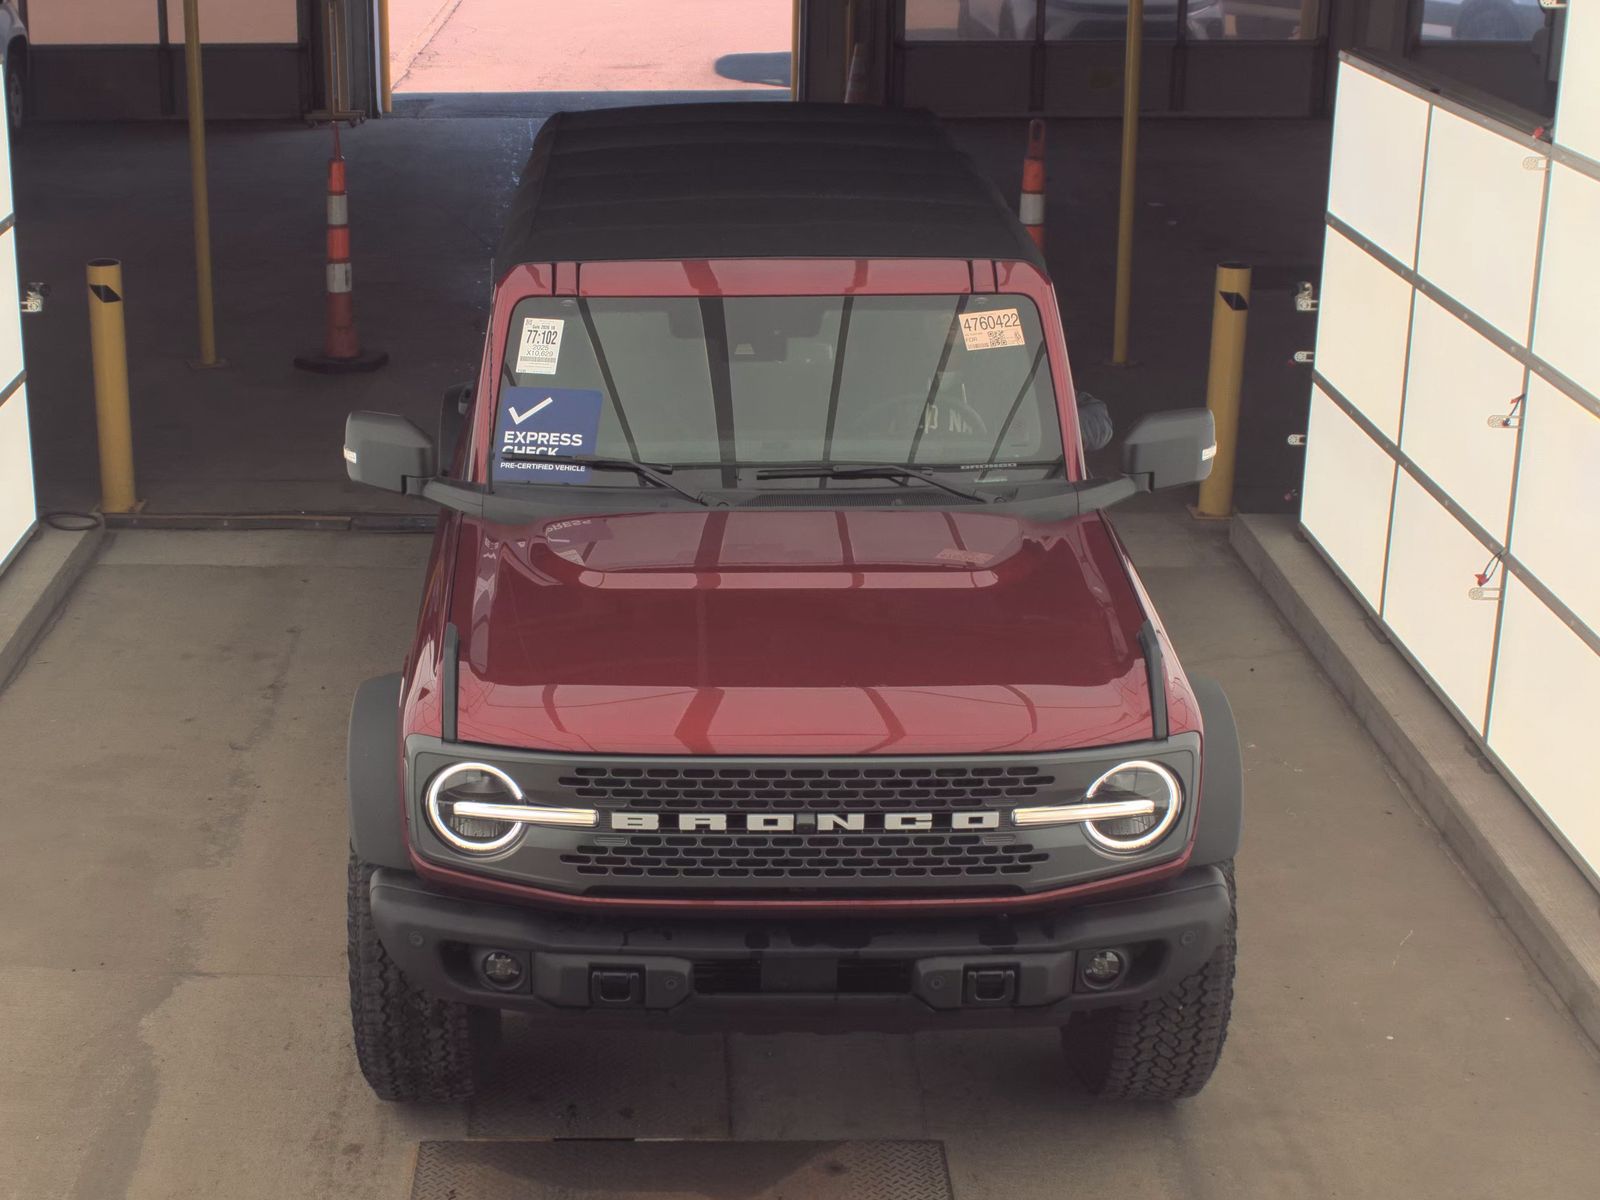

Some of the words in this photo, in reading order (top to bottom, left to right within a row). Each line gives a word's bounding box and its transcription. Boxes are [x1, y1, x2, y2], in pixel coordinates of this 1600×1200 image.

[963, 313, 1020, 331] 4760422
[526, 330, 558, 344] 77:102
[503, 430, 583, 447] EXPRESS
[500, 462, 554, 471] PRE-CERTIFIED
[555, 464, 586, 472] VEHICLE
[611, 811, 1000, 831] BRONCO
